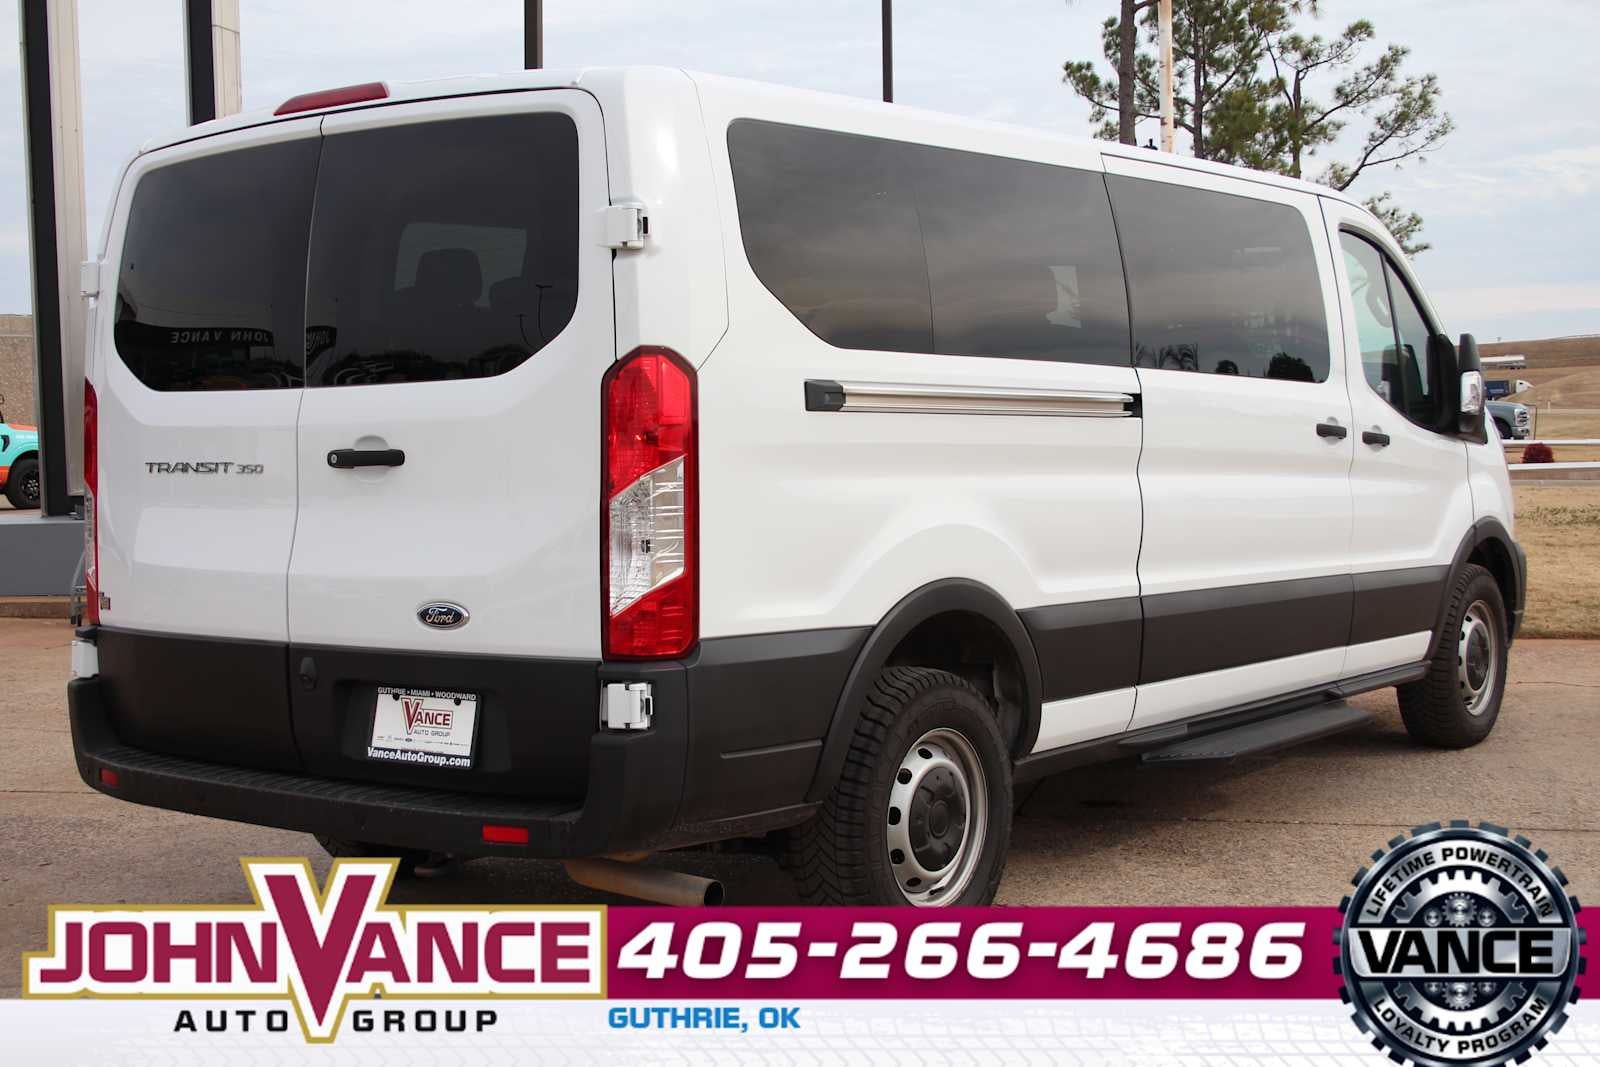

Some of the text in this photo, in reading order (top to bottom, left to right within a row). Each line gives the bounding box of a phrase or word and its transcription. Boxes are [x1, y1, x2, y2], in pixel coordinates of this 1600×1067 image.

[145, 462, 263, 475] TRANSIT 350
[426, 607, 455, 625] Ford
[377, 687, 476, 701] GUTHRIE MIAMI WOODWARD
[403, 699, 452, 732] VANCE
[367, 747, 471, 767] VanceAutoGroup.com
